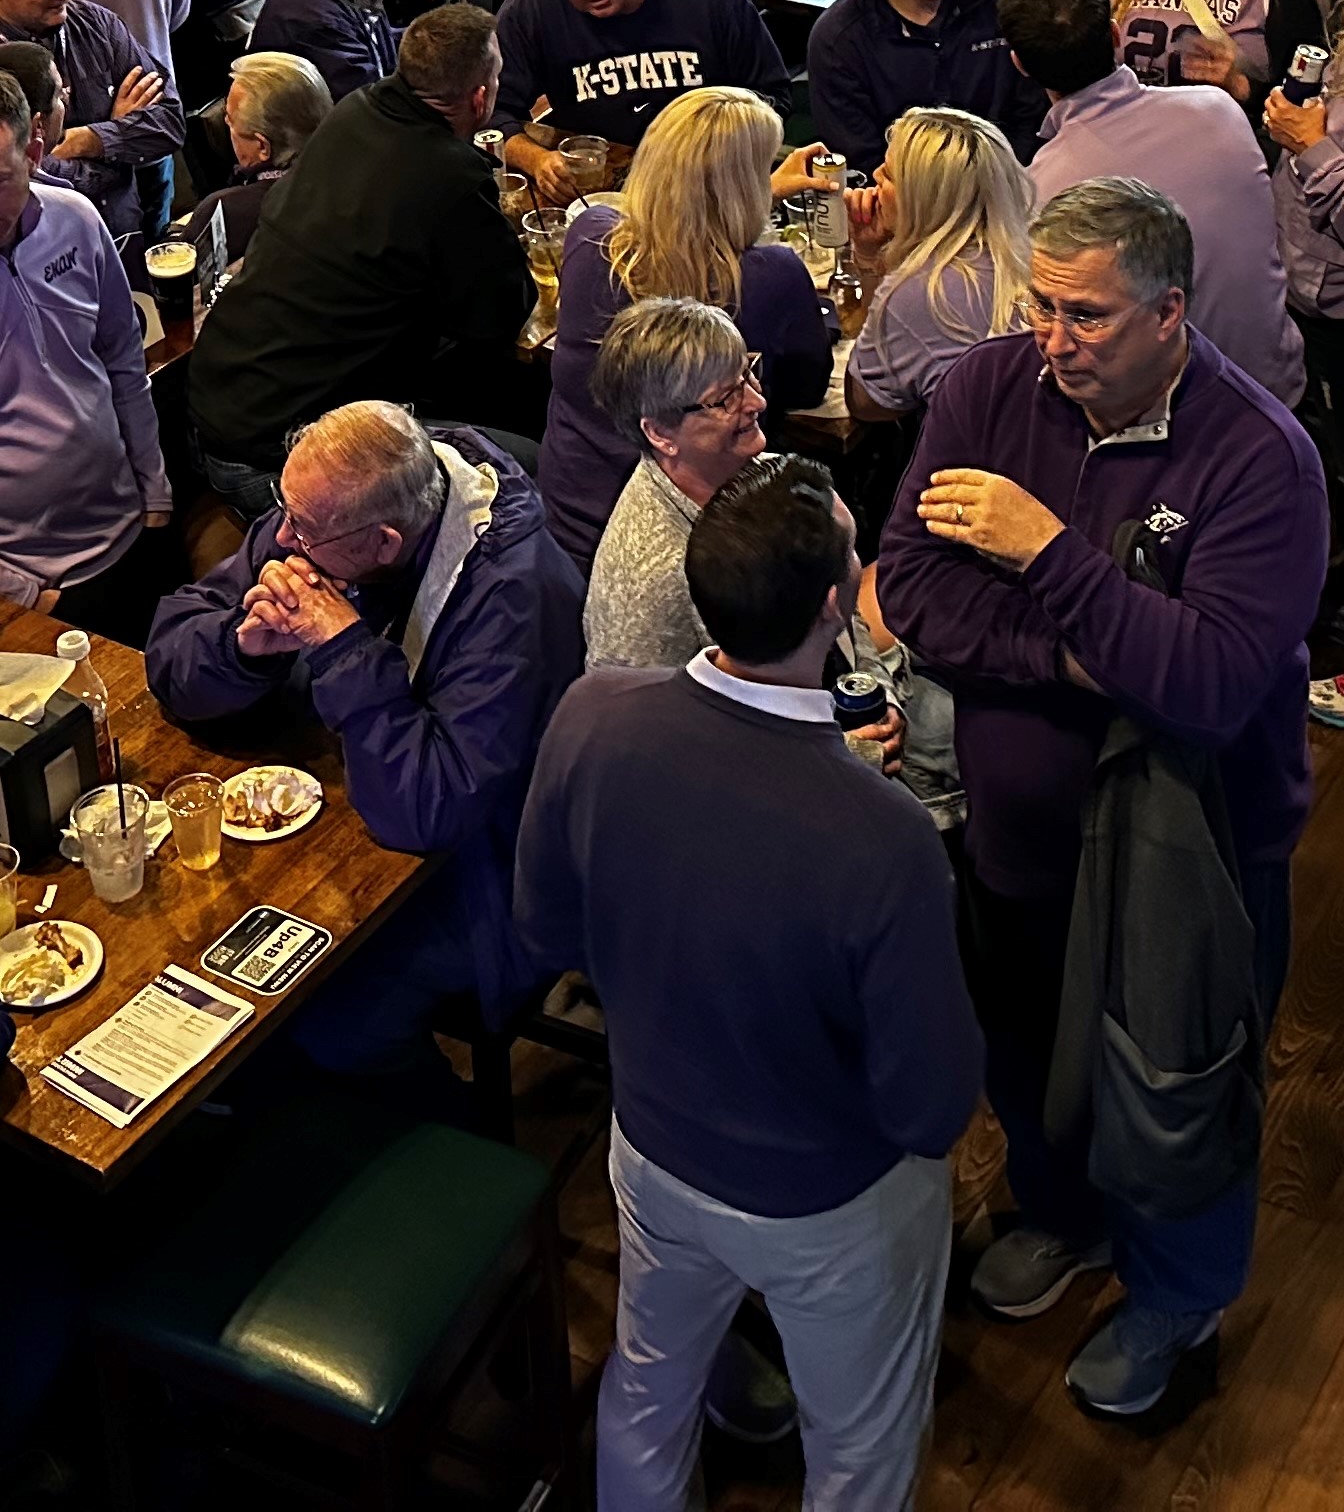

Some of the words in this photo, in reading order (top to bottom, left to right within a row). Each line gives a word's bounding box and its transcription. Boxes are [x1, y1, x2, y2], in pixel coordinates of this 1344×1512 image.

[571, 50, 704, 103] K-STATE
[44, 246, 78, 283] EMAW
[262, 925, 303, 959] Up4B
